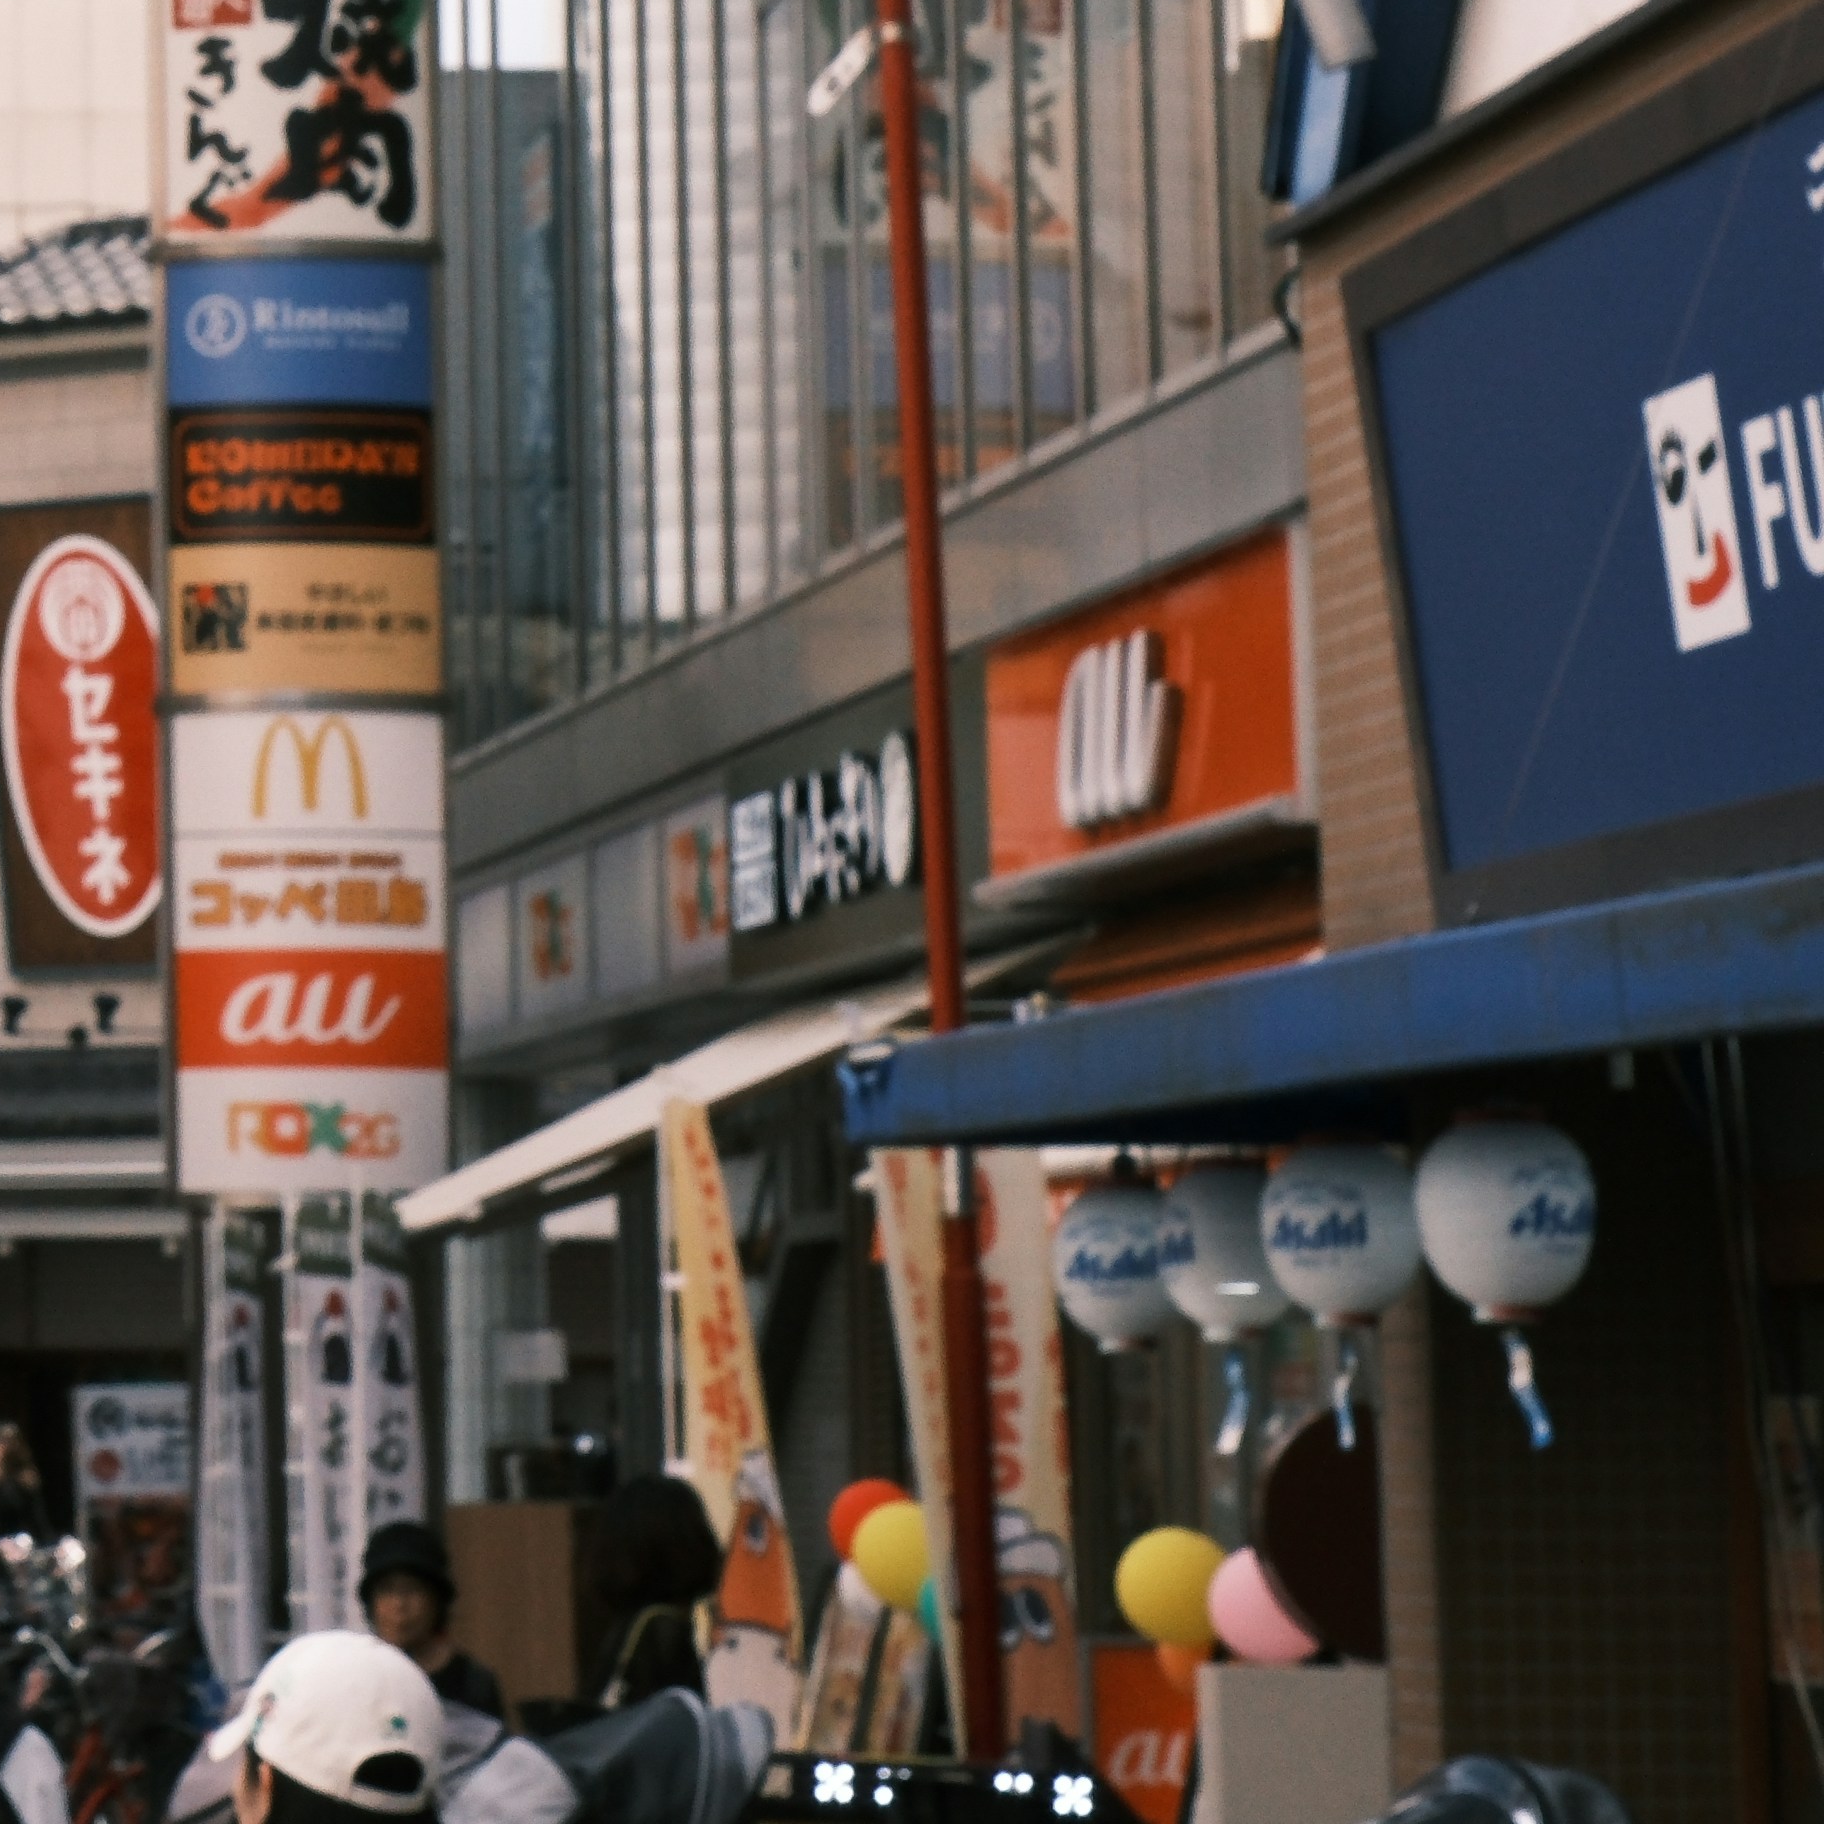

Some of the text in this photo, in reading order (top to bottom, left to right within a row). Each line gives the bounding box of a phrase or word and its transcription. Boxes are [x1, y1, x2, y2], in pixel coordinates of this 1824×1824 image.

[60, 666, 134, 906] セキネ
[221, 971, 402, 1046] au
